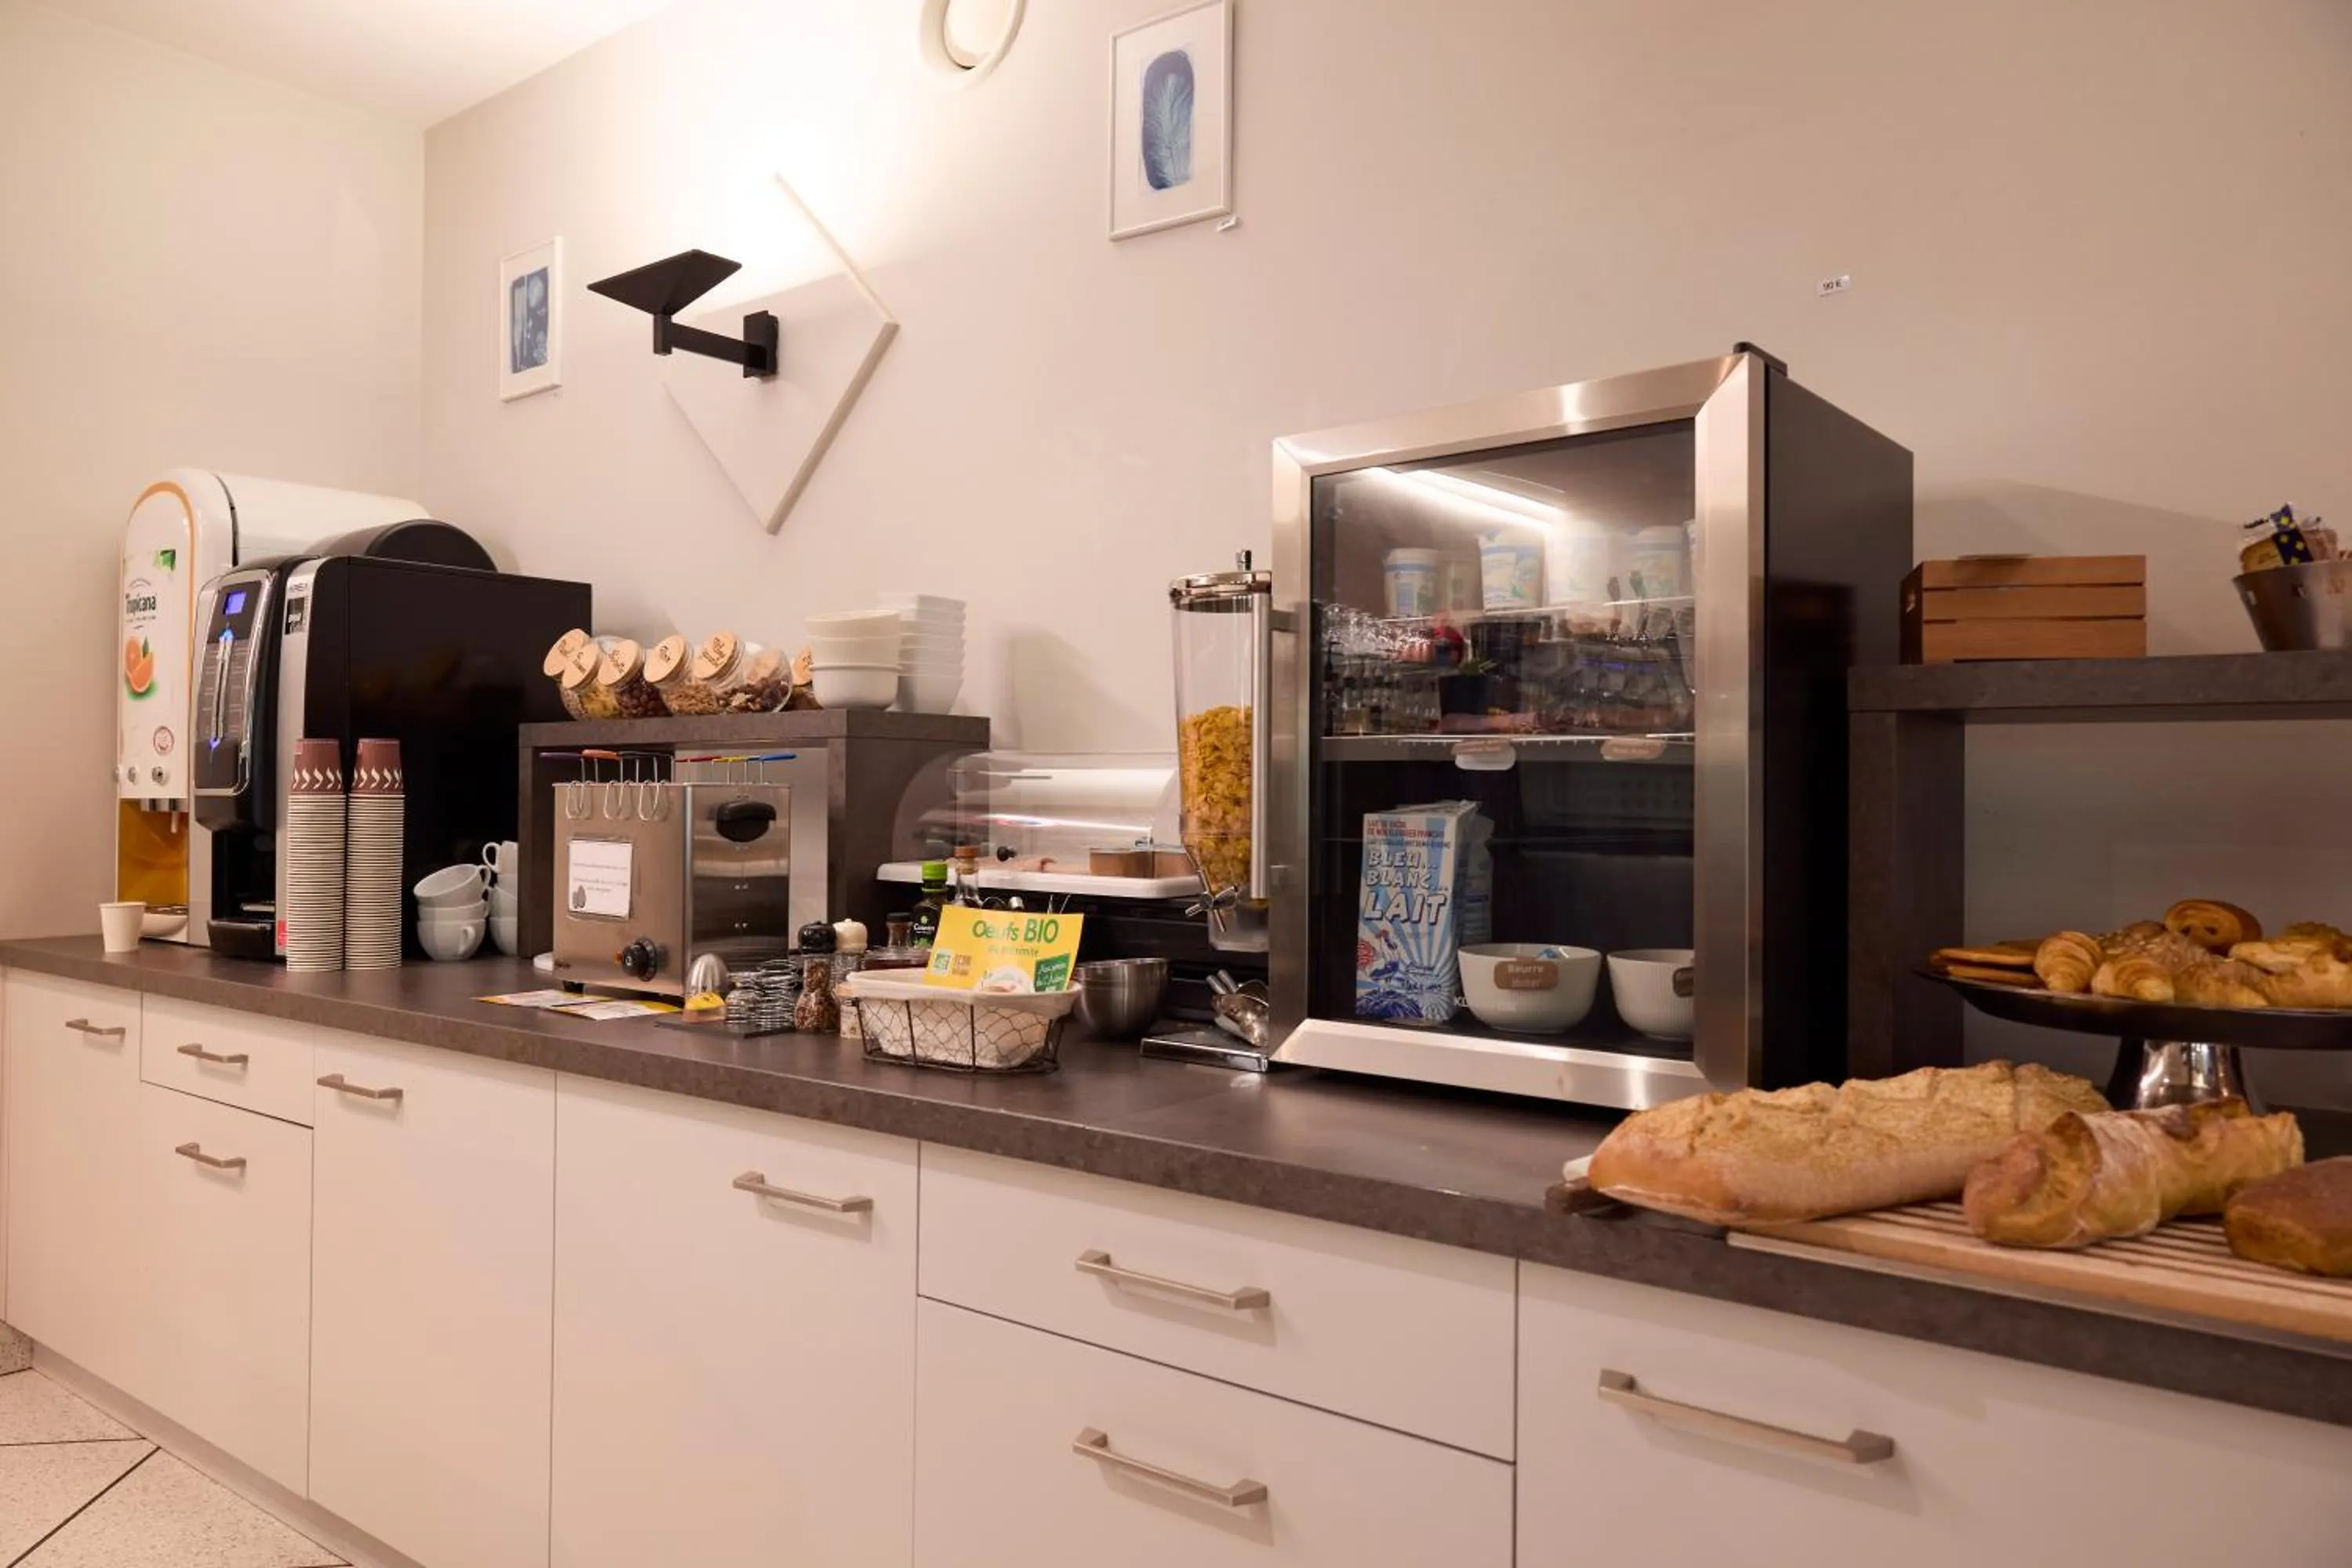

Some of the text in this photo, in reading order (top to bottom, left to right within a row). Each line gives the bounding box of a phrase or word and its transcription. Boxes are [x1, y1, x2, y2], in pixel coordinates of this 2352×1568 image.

[1364, 891, 1447, 926] LAIT
[1024, 918, 1060, 945] BIO
[1507, 964, 1544, 975] Beurre
